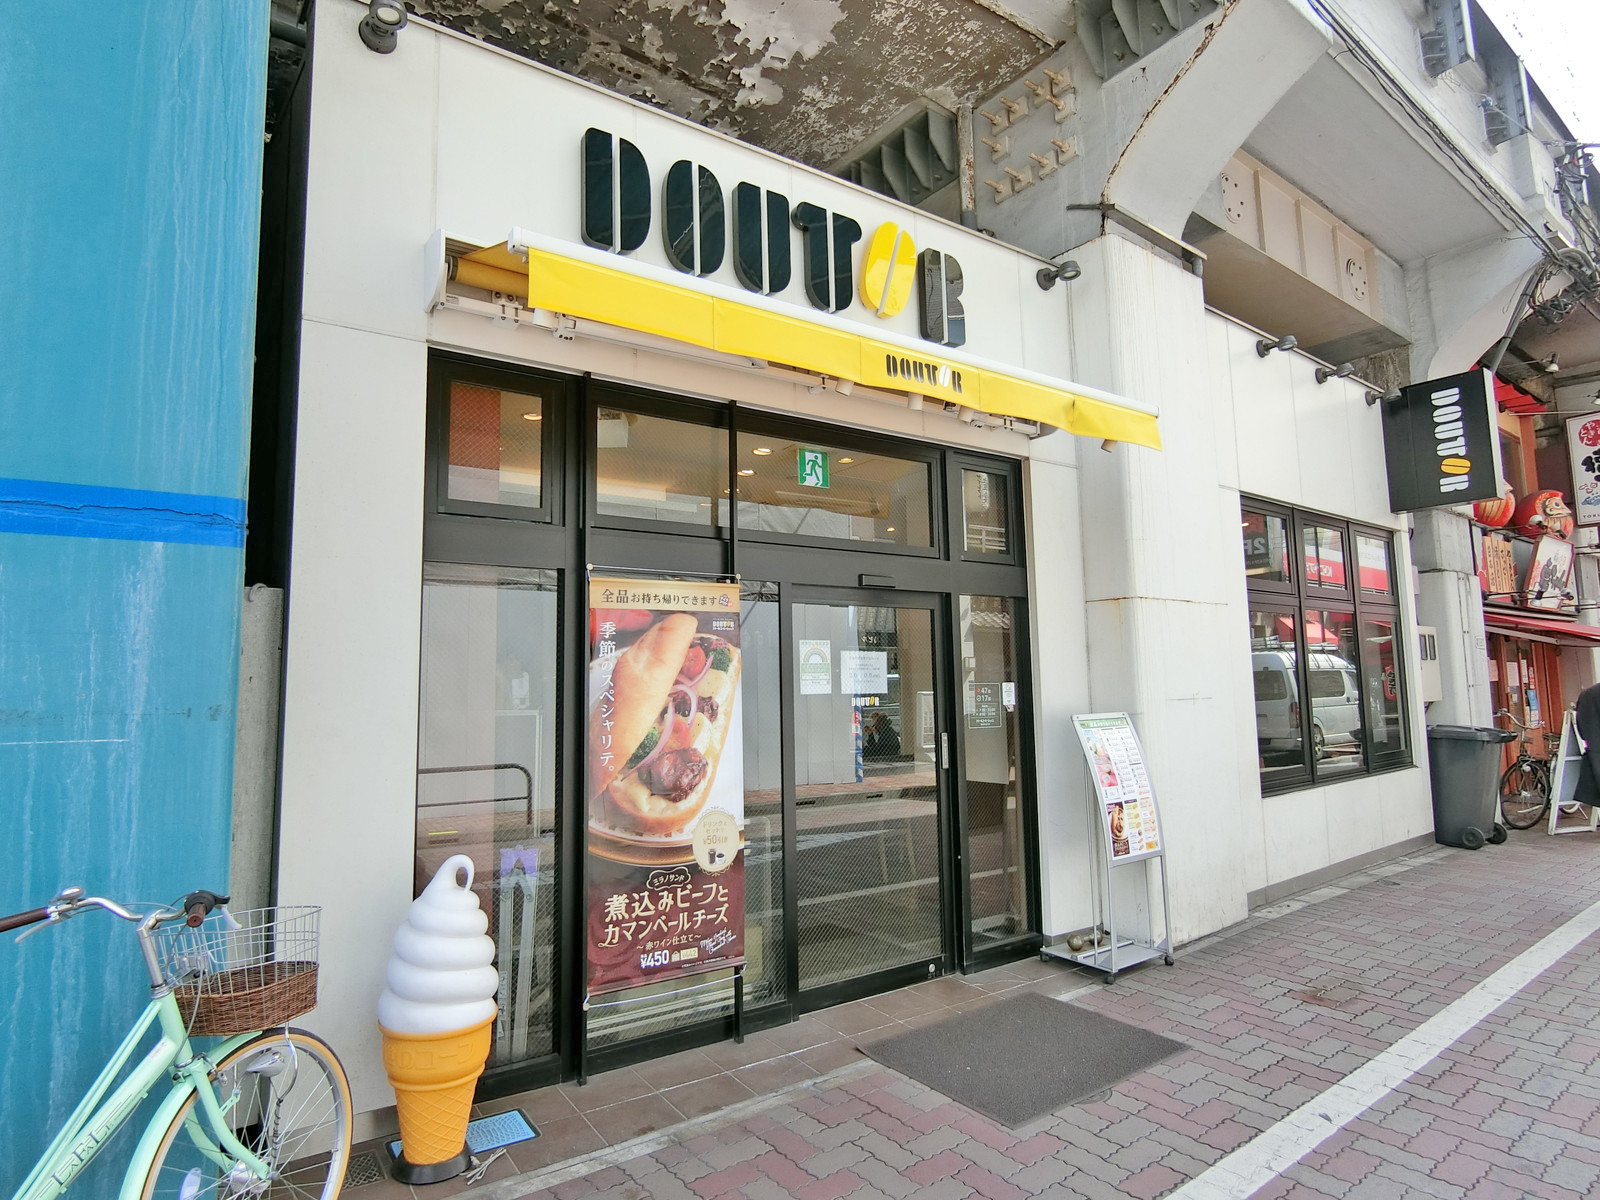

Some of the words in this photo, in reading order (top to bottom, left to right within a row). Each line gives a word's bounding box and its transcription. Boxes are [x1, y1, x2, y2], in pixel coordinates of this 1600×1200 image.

[580, 127, 966, 348] DOUTOR
[885, 353, 963, 393] DOUTOR
[1430, 387, 1471, 492] DOUTOR
[601, 588, 717, 606] 全品お持ち帰りできます
[604, 882, 729, 922] 煮込みビーフと
[598, 903, 730, 947] カマンベールチーズ
